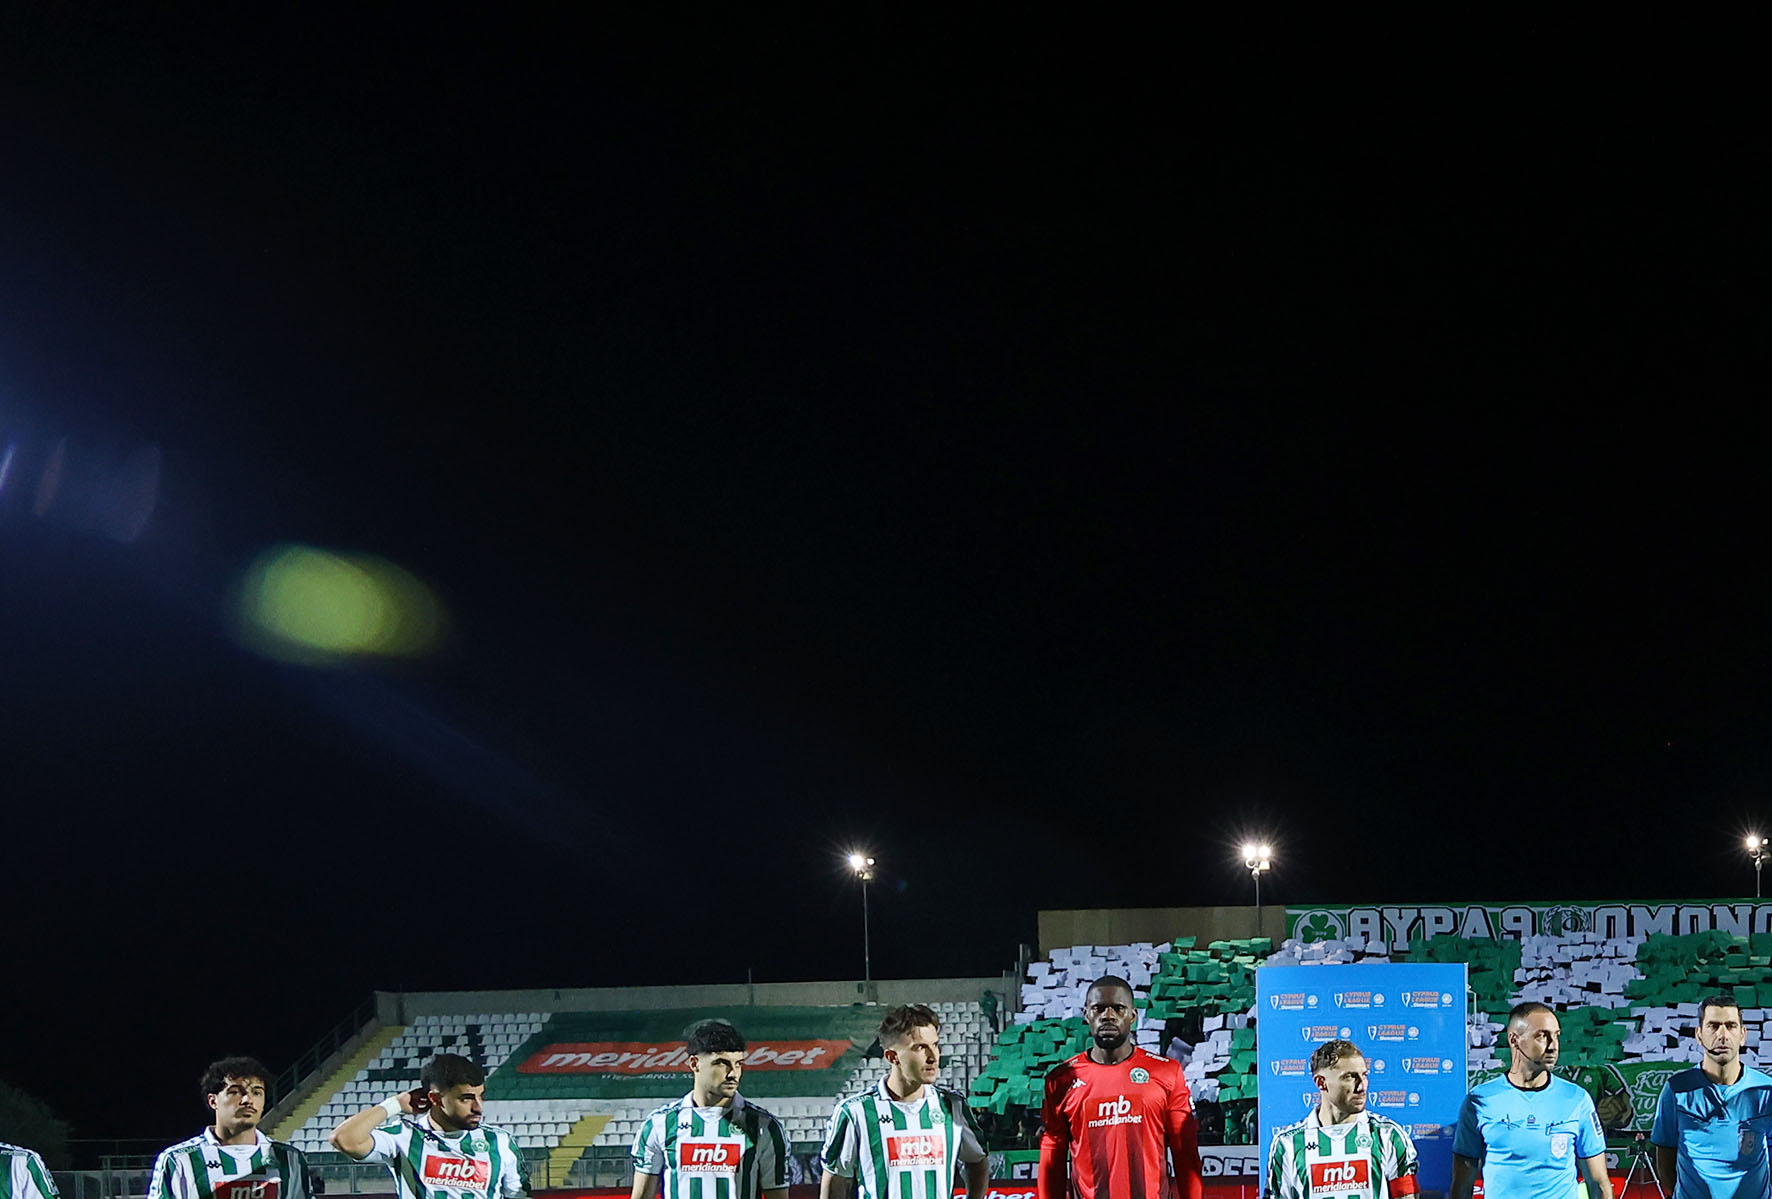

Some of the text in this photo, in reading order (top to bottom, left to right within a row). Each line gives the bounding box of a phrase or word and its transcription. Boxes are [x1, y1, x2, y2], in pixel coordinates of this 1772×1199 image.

[1099, 1095, 1131, 1118] mb
[1088, 1114, 1142, 1128] meridianbet
[692, 1144, 728, 1163] mb
[900, 1138, 933, 1155] mb
[438, 1158, 476, 1178] mb
[681, 1162, 737, 1173] meridianbet
[889, 1156, 944, 1167] meridianbet
[1323, 1163, 1357, 1182] mb
[231, 1181, 265, 1199] mb
[424, 1175, 486, 1191] meridianbet
[1313, 1179, 1369, 1193] meridianbet
